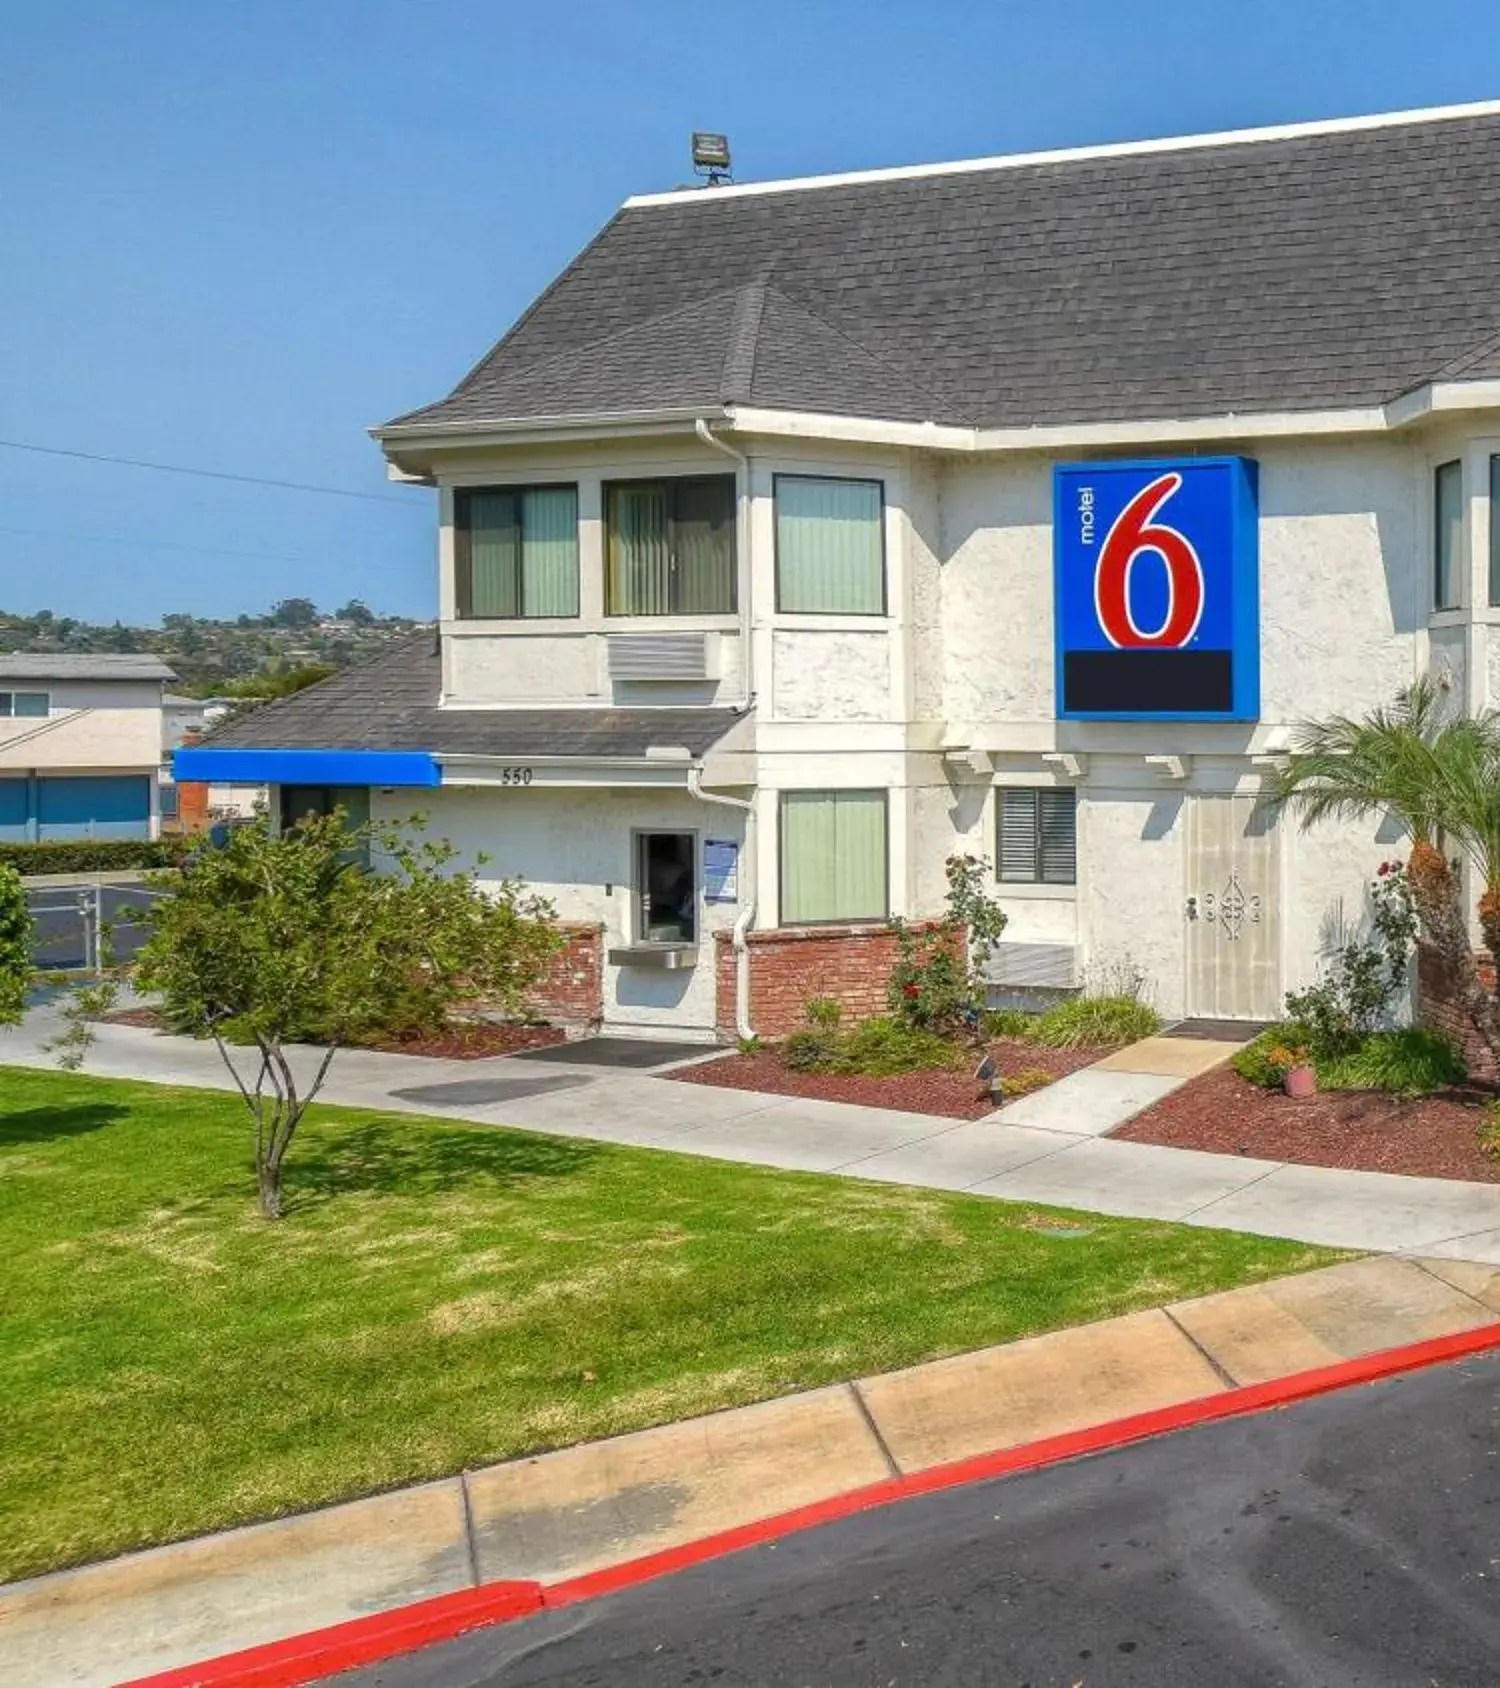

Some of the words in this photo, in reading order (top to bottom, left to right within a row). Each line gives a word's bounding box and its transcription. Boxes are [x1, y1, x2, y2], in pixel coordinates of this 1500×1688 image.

[1077, 487, 1094, 544] motel
[1093, 471, 1205, 649] 6
[501, 767, 533, 785] 550
